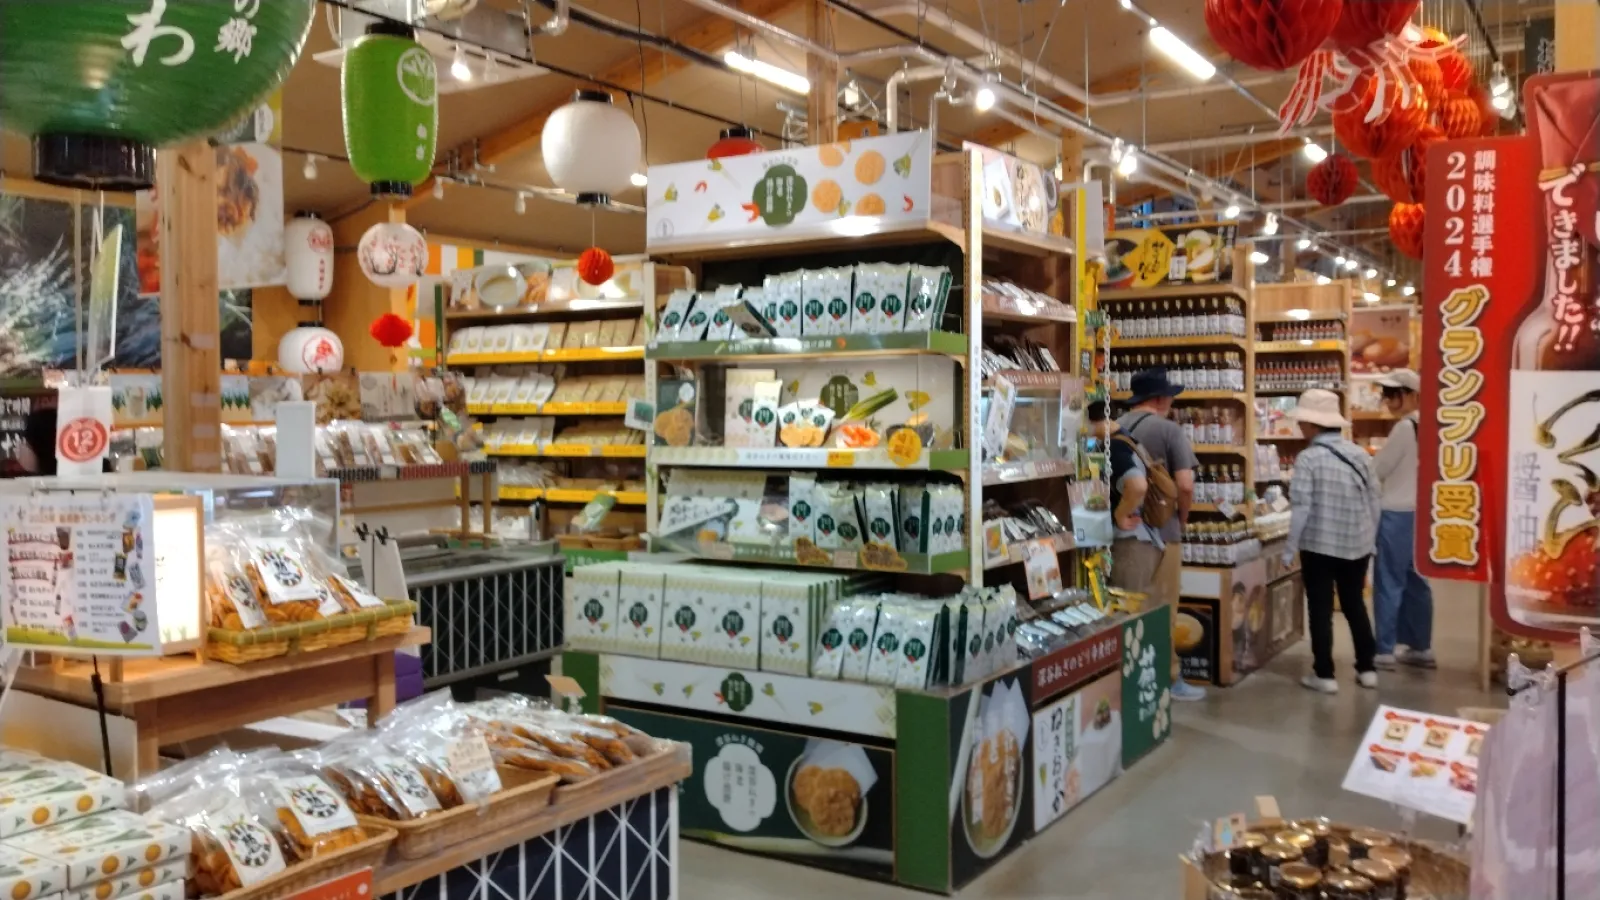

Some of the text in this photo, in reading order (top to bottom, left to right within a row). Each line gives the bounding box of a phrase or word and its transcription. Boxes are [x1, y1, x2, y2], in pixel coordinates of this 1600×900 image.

[1444, 151, 1468, 277] 2024
[1470, 149, 1497, 279] 調味料選手権
[1431, 285, 1489, 564] グランプリ受賞
